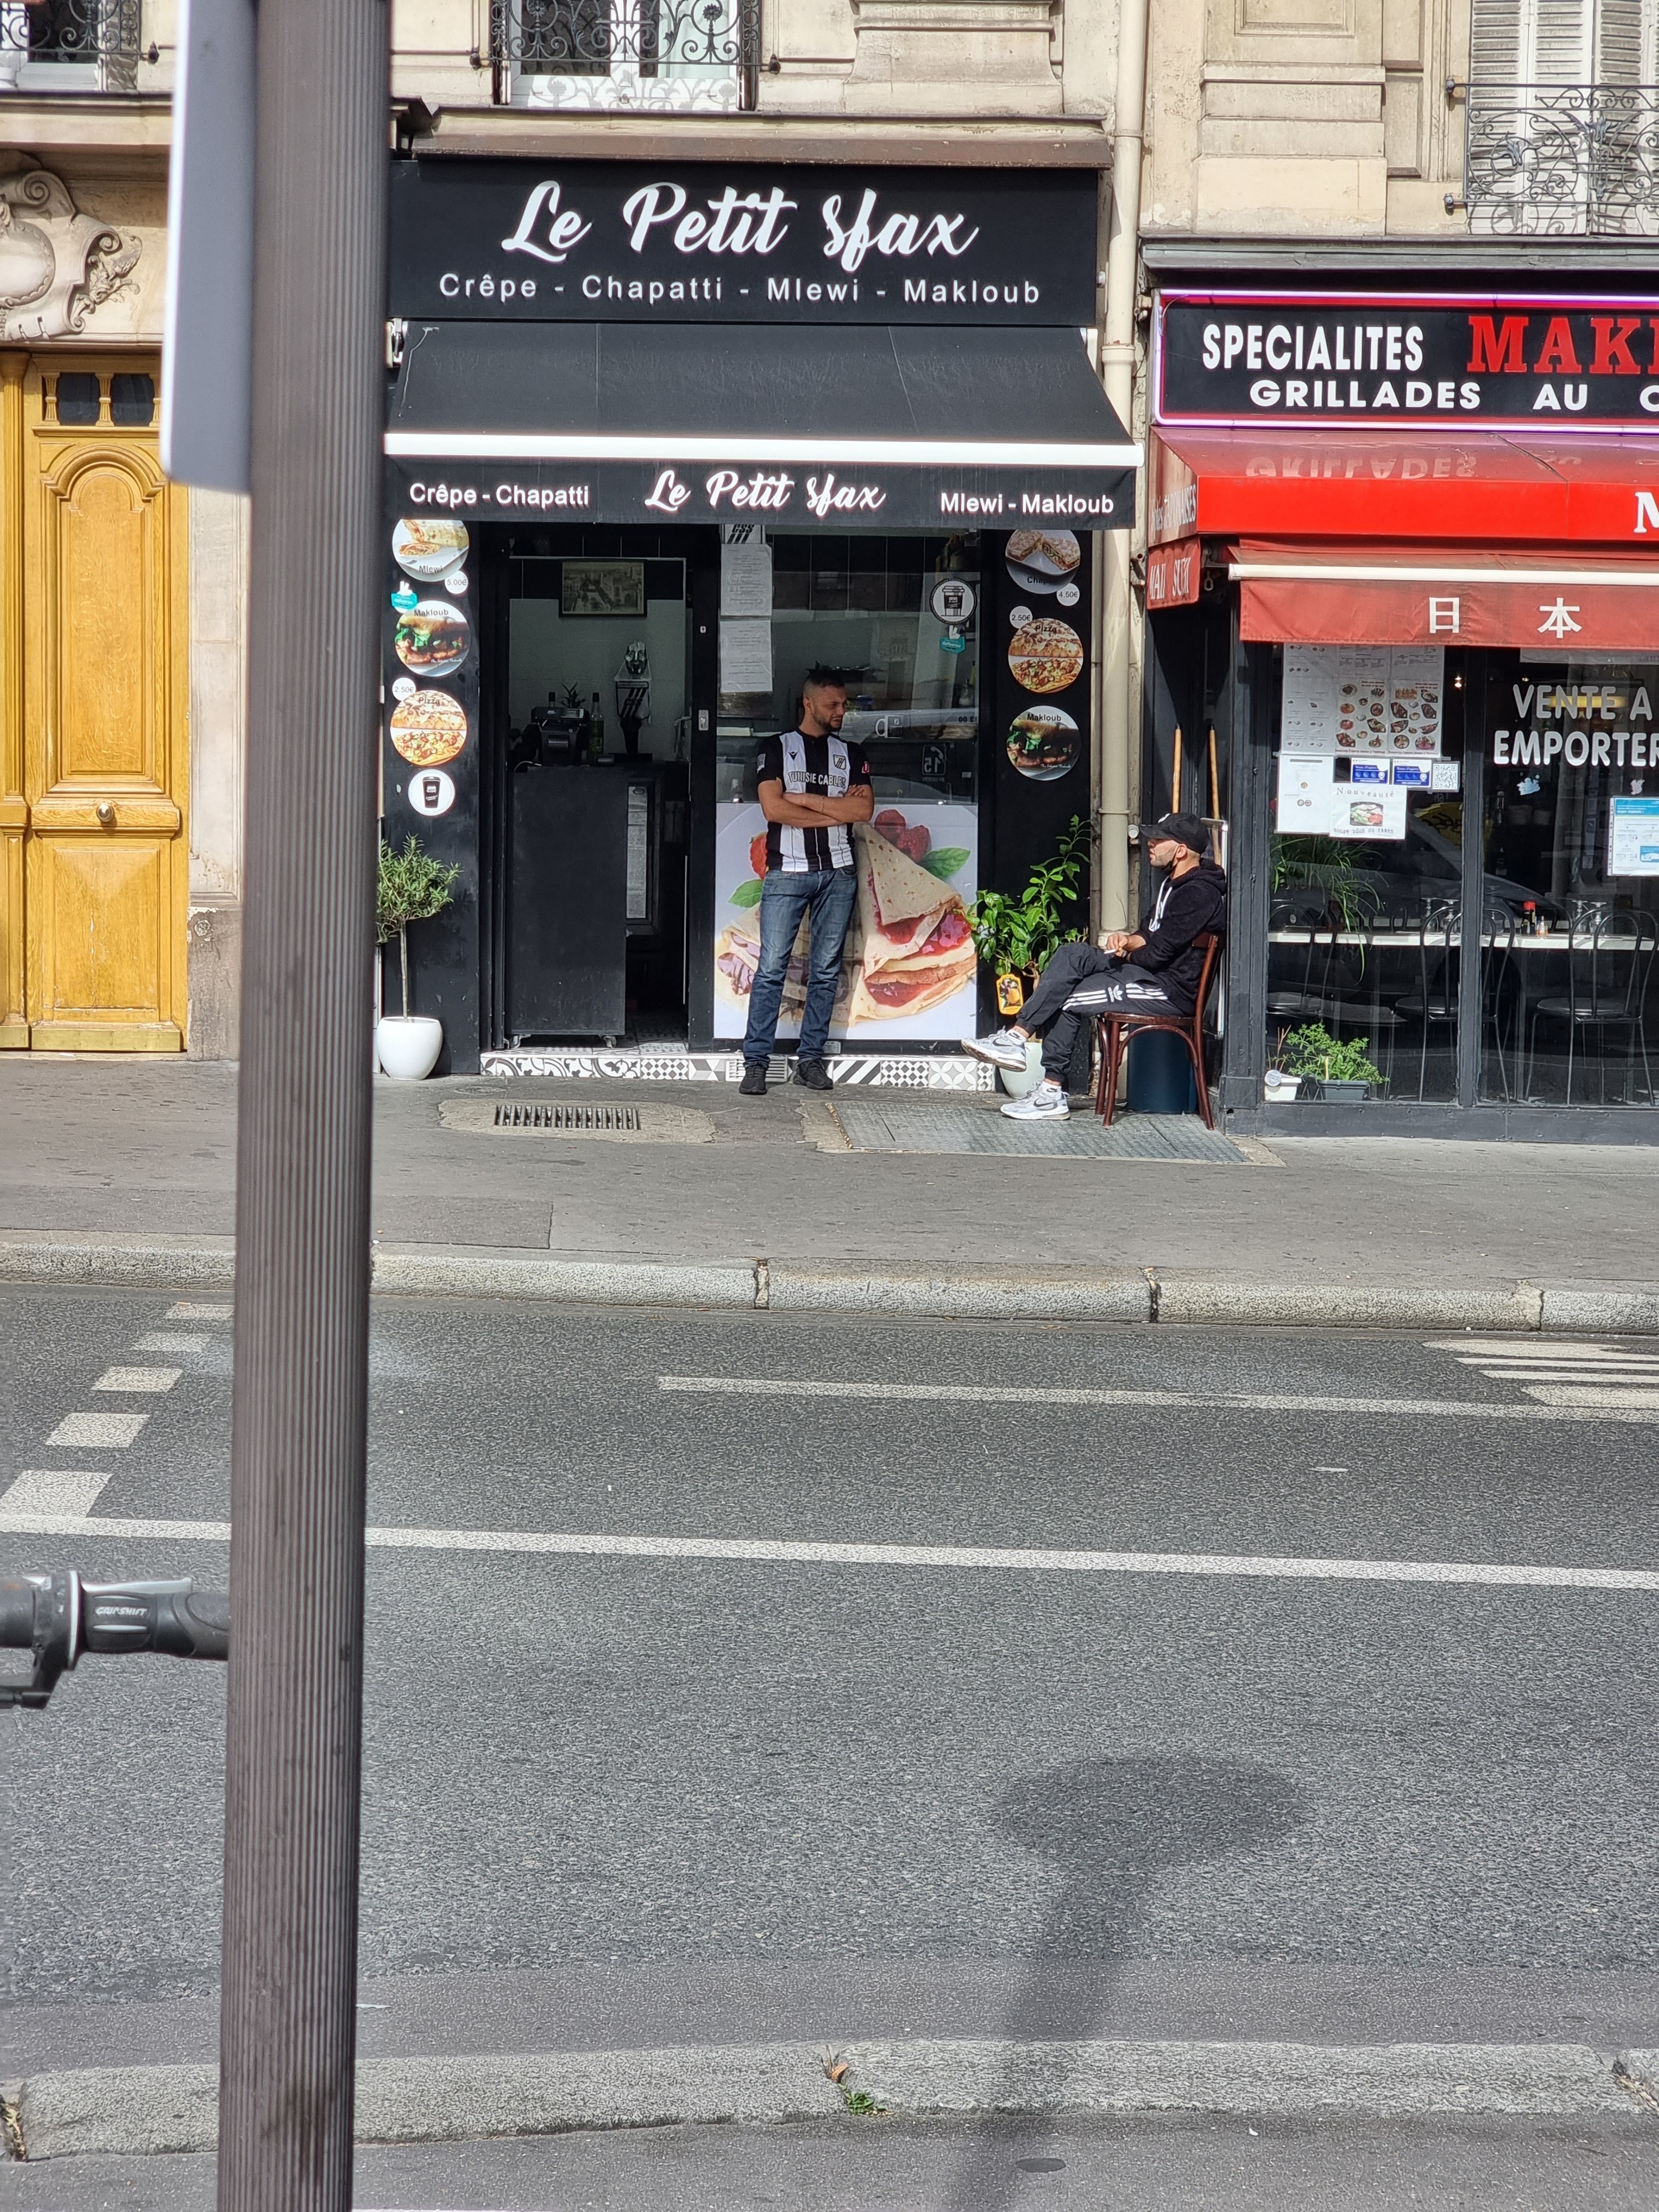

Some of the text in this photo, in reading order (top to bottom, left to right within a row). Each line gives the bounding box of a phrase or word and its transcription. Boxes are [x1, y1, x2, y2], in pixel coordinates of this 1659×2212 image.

[500, 180, 980, 273] Le Petit Sfax
[439, 272, 537, 303] Crêpe
[582, 274, 722, 305] Chapatti
[767, 277, 859, 302] Mlewi
[904, 278, 1040, 304] Makloub
[1202, 324, 1424, 372] SPECIALITES
[1250, 379, 1481, 410] GRILLADES
[1532, 383, 1588, 411] AU
[410, 482, 477, 509] Crêpe
[495, 484, 589, 510] Chapatti
[644, 469, 887, 518] Le Petit Sfax
[940, 492, 1003, 514] Mlewi
[1021, 493, 1114, 514] Makloub
[419, 565, 443, 574] Mlewi
[1026, 713, 1062, 722] Makloub
[1512, 684, 1653, 721] VENTE A
[818, 774, 846, 789] CABLES
[1336, 787, 1394, 798] Nouveauté
